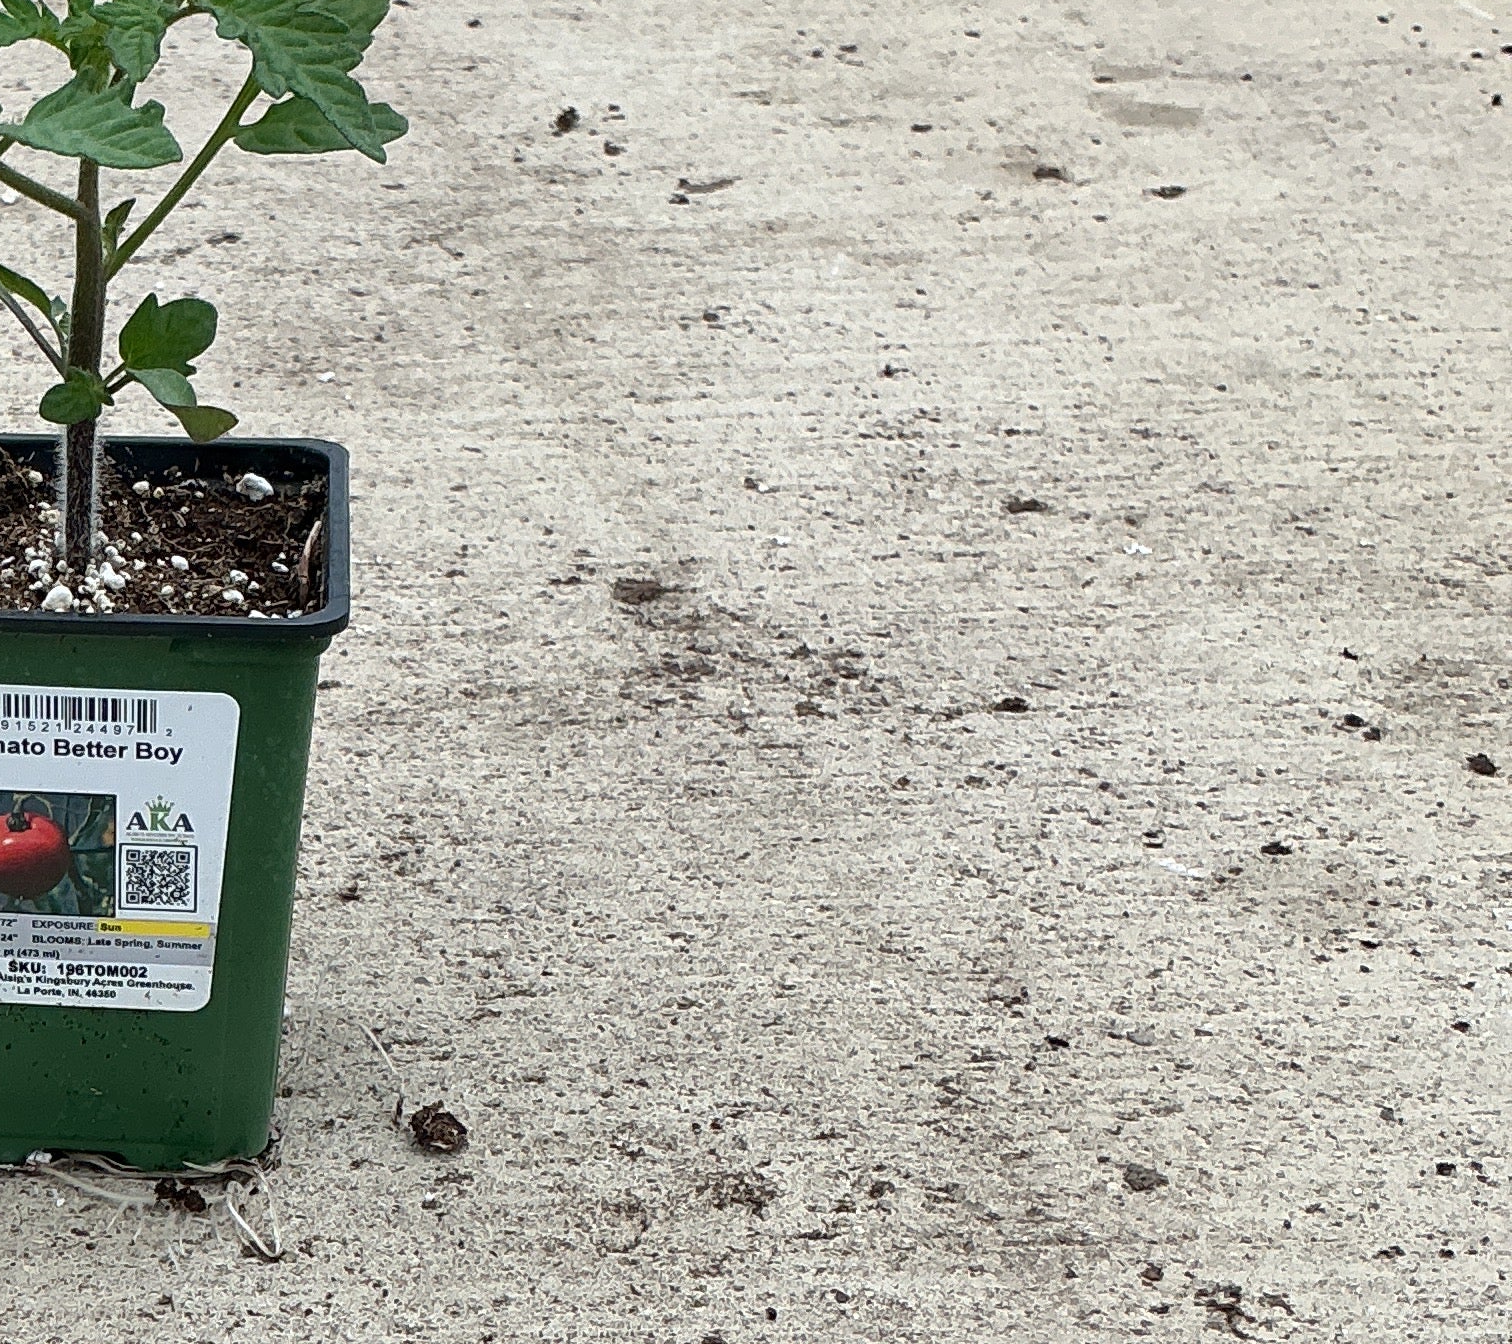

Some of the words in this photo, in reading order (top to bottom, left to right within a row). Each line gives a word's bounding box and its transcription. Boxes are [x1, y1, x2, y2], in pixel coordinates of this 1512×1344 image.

[1, 719, 62, 733] 91521
[73, 723, 135, 736] 24497
[54, 738, 128, 759] Better
[135, 741, 183, 766] Boy
[126, 811, 194, 833] AKA
[100, 922, 122, 932] Sun
[32, 935, 85, 945] BLOOMS:
[88, 937, 112, 947] Late
[115, 938, 153, 950] Spring,
[157, 939, 202, 951] Summer
[3, 949, 15, 958] pt
[17, 949, 40, 959] (473
[43, 950, 60, 959] ml)
[8, 959, 47, 975] SKU:
[57, 963, 148, 979] 196TOM002
[35, 975, 90, 988] Kingsbury
[92, 977, 124, 988] Acres
[17, 986, 31, 995] La
